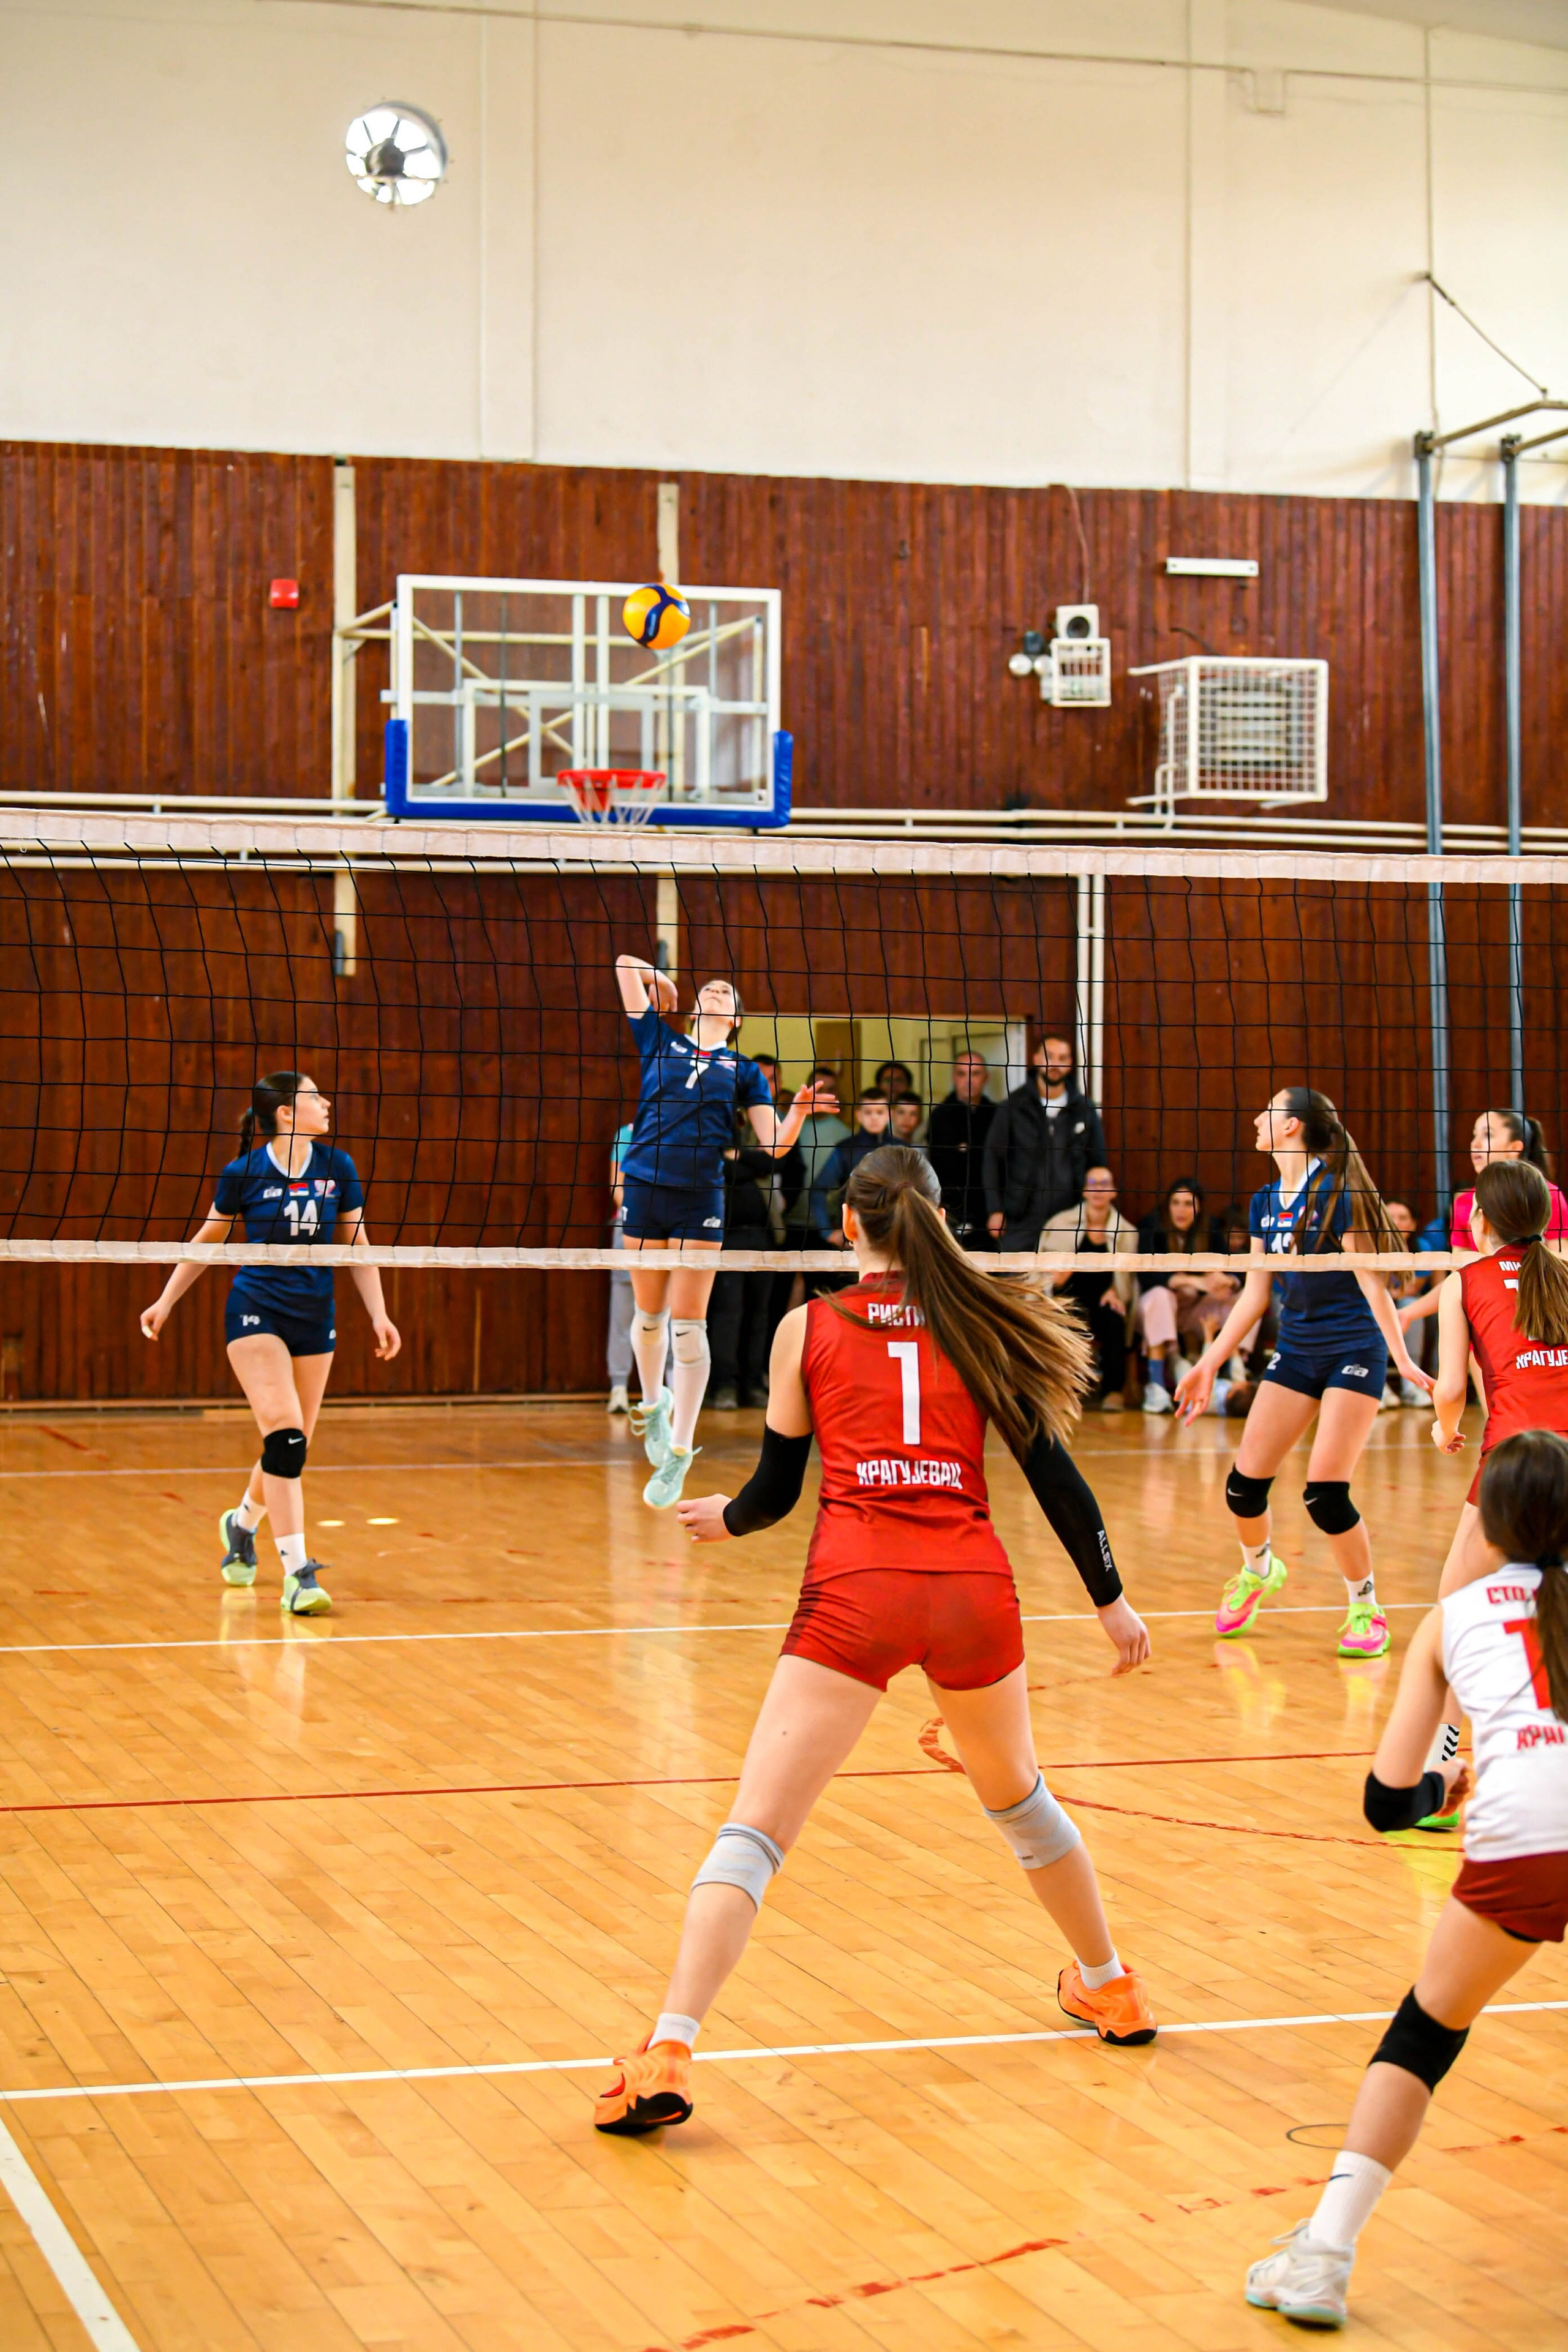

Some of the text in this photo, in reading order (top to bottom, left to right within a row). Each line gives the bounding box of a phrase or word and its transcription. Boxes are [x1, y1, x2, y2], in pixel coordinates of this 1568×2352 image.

[685, 1060, 709, 1089] 7
[284, 1199, 320, 1236] 14
[887, 1341, 920, 1445] 1
[856, 1460, 963, 1490] КРАГУЈЕВАЦ
